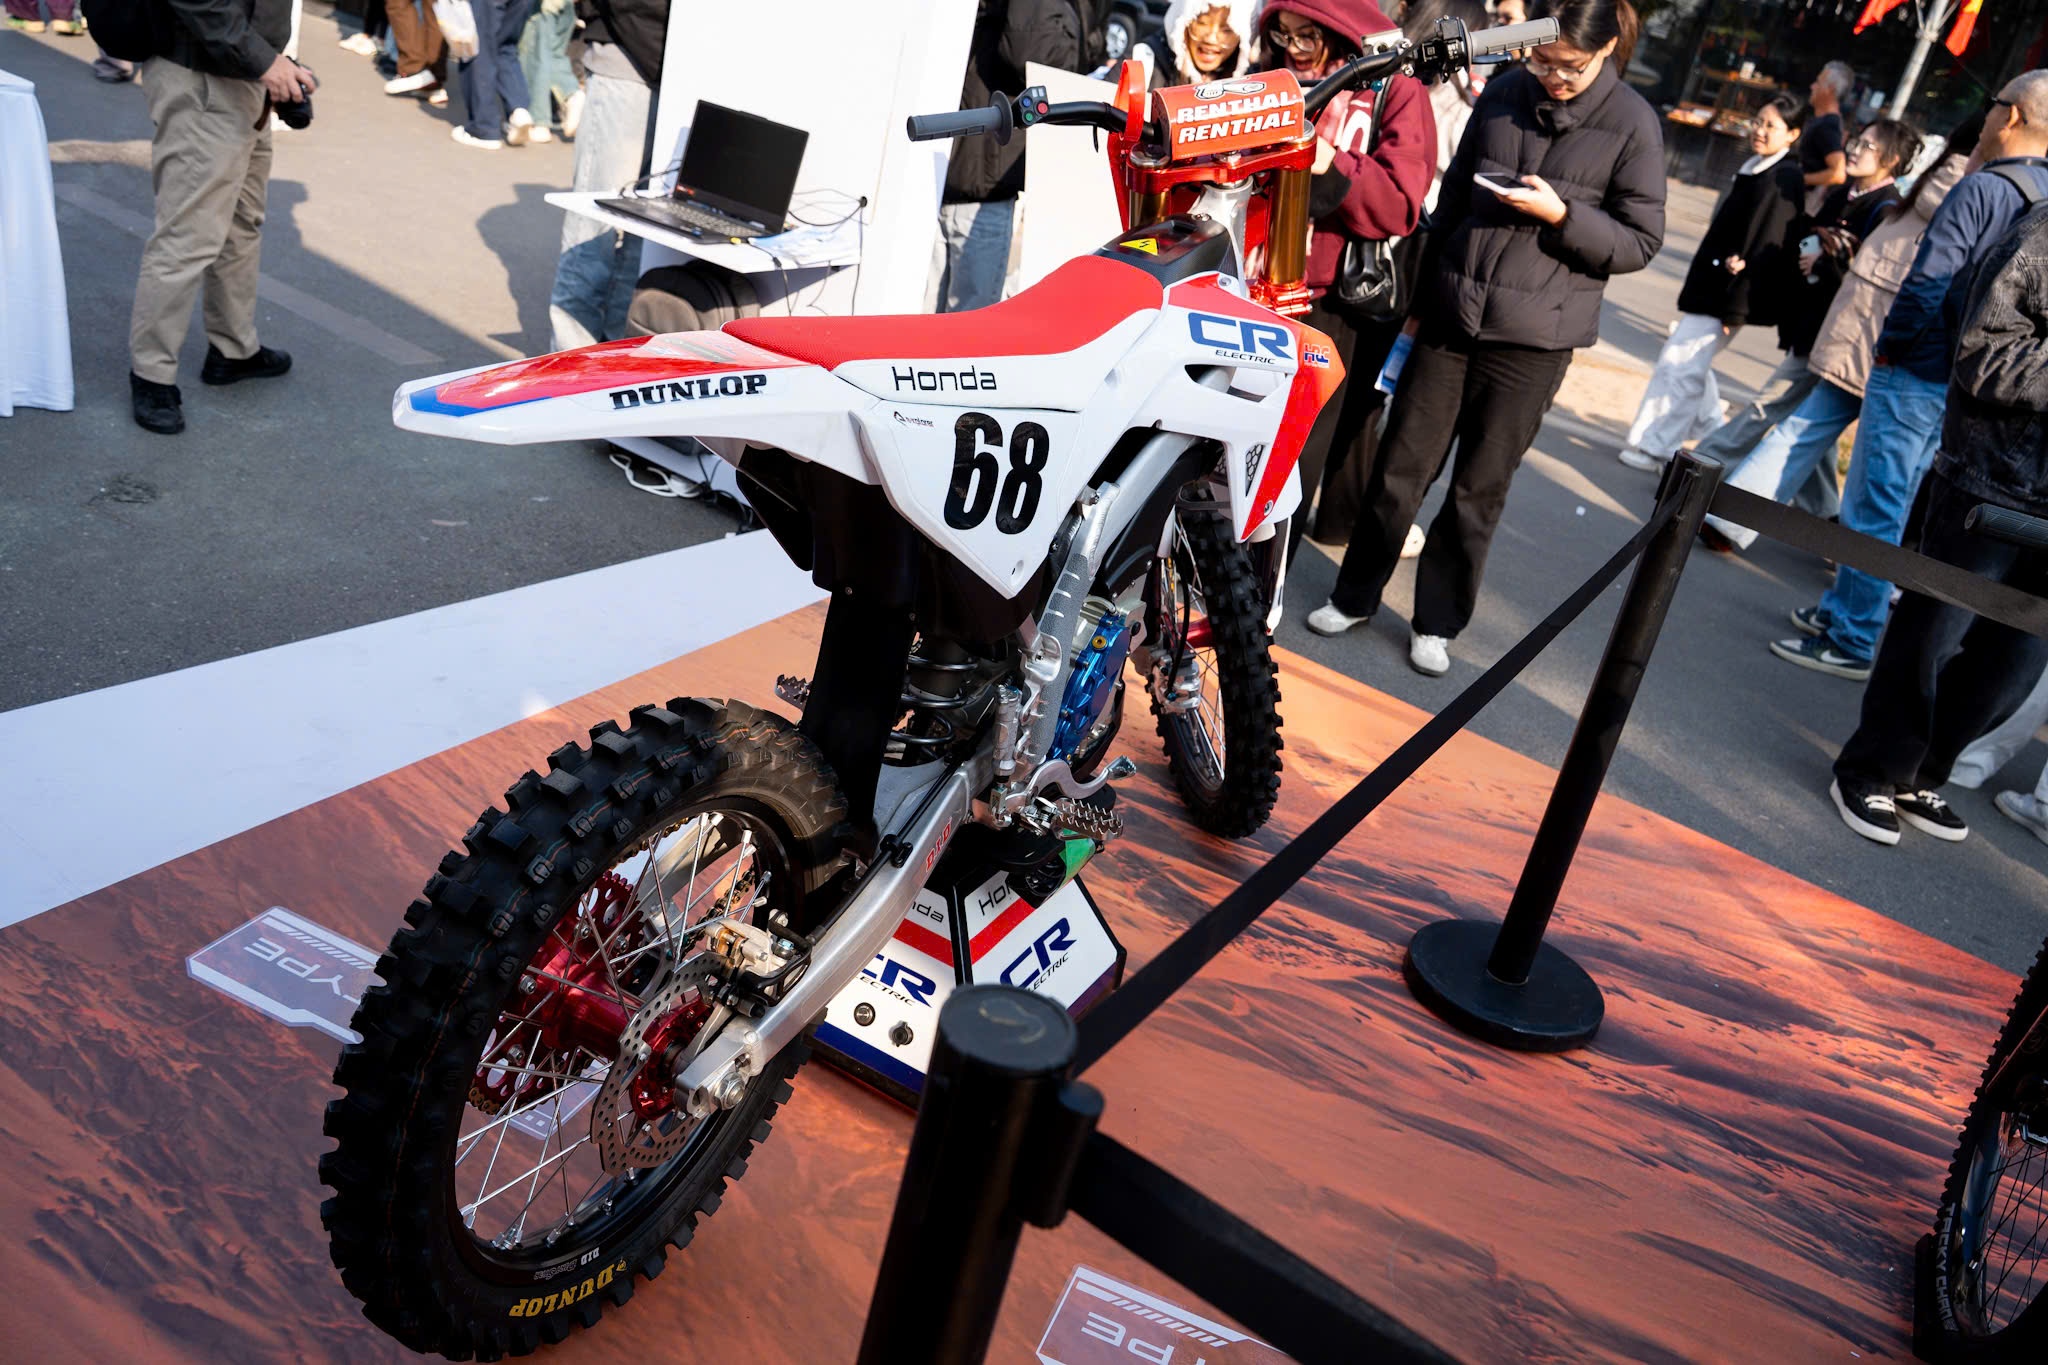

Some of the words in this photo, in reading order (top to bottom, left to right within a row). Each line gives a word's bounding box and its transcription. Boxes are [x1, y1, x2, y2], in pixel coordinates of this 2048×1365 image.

[1176, 91, 1295, 124] RENTHAL
[1178, 110, 1296, 144] RENTHAL
[1188, 312, 1294, 360] CR
[1215, 350, 1276, 365] ELECTRIC
[609, 374, 767, 410] DUNLOP
[891, 365, 998, 391] Honda
[943, 412, 1050, 535] 68
[1000, 917, 1077, 989] CR
[855, 976, 917, 1007] ECTRIC
[509, 1263, 615, 1318] DUNLOP
[1080, 1311, 1207, 1365] PE
